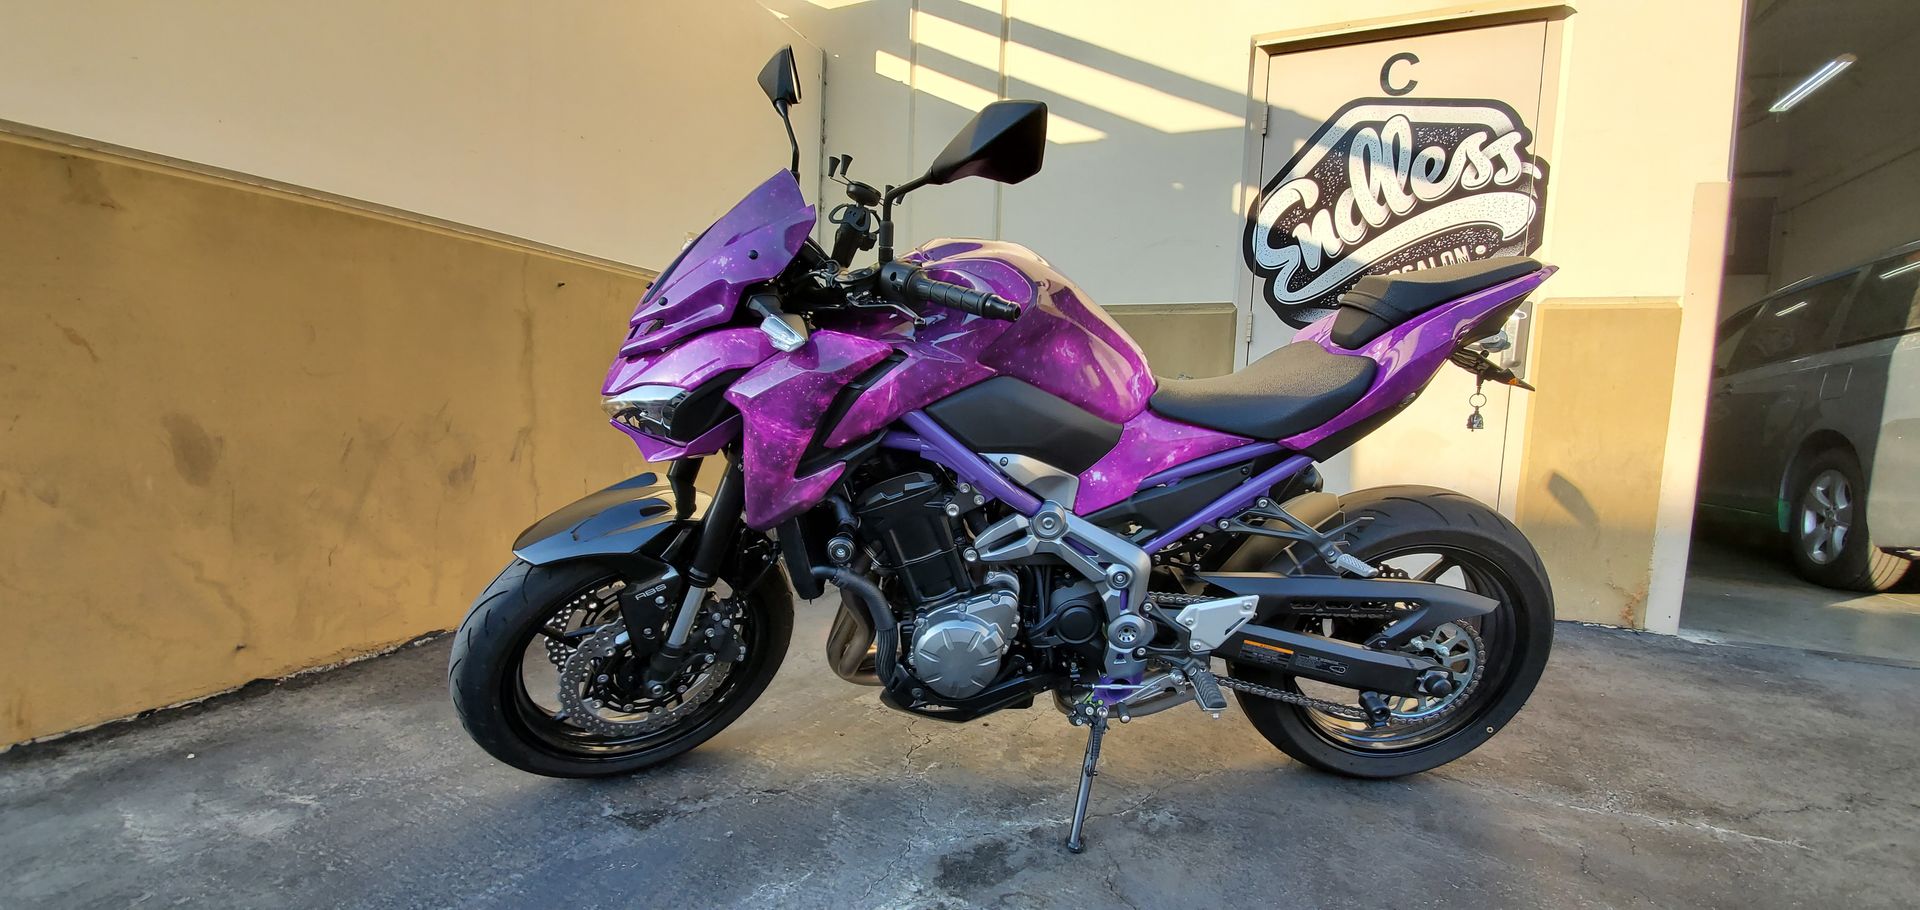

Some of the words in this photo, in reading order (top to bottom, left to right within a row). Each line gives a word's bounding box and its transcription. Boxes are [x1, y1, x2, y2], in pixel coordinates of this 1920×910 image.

[1380, 52, 1420, 96] C
[1252, 114, 1541, 304] Endless
[635, 583, 667, 601] ABS
